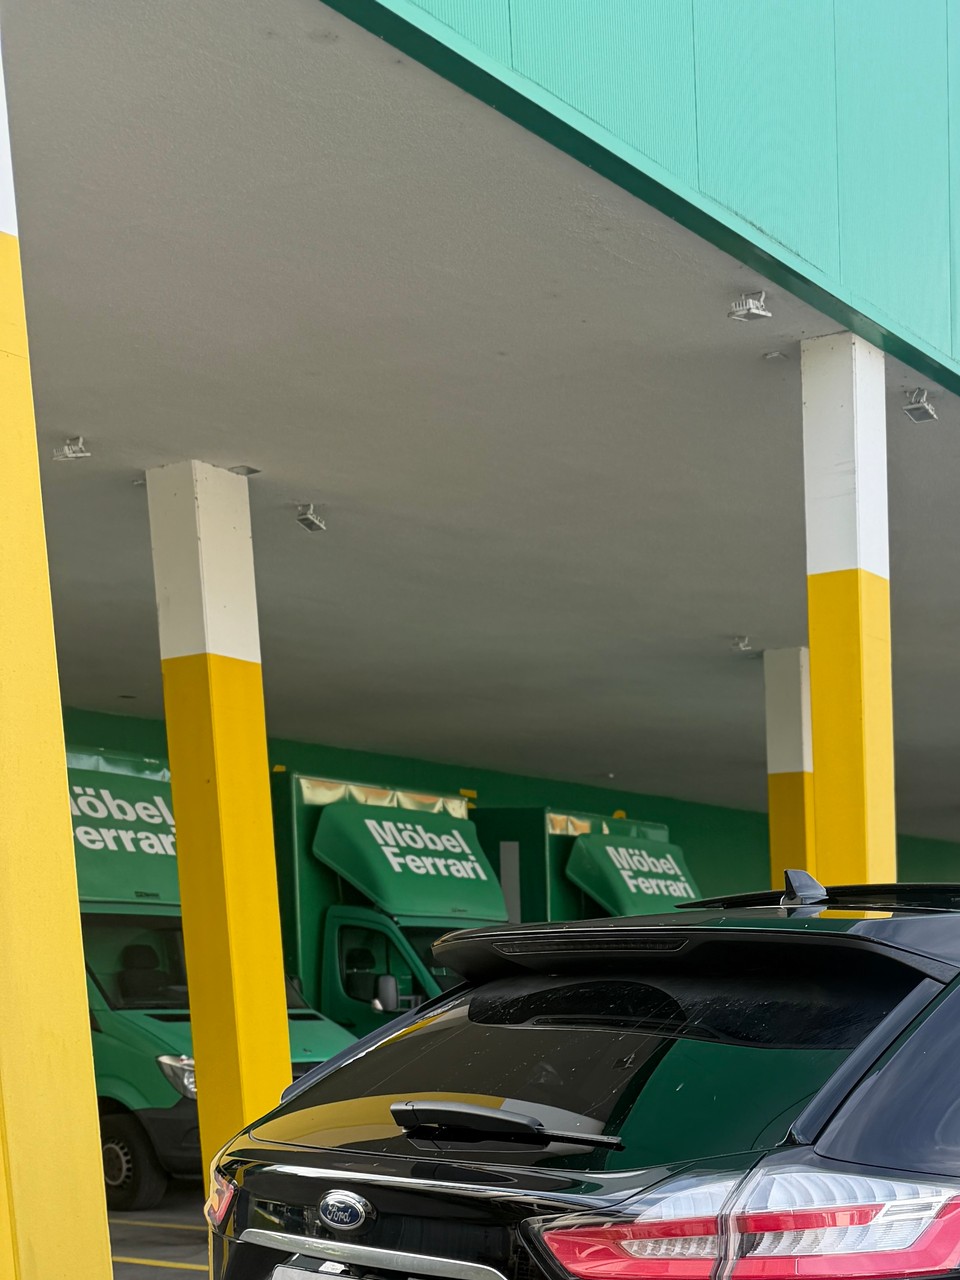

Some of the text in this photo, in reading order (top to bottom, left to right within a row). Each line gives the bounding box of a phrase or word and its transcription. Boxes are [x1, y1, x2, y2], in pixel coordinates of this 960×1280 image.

[70, 785, 176, 826] öbel
[73, 826, 177, 856] errar
[364, 818, 472, 854] Möbel
[381, 845, 488, 880] Ferrari
[605, 846, 682, 876] Möbel
[620, 869, 696, 899] Ferrari
[326, 1201, 352, 1223] Ford
